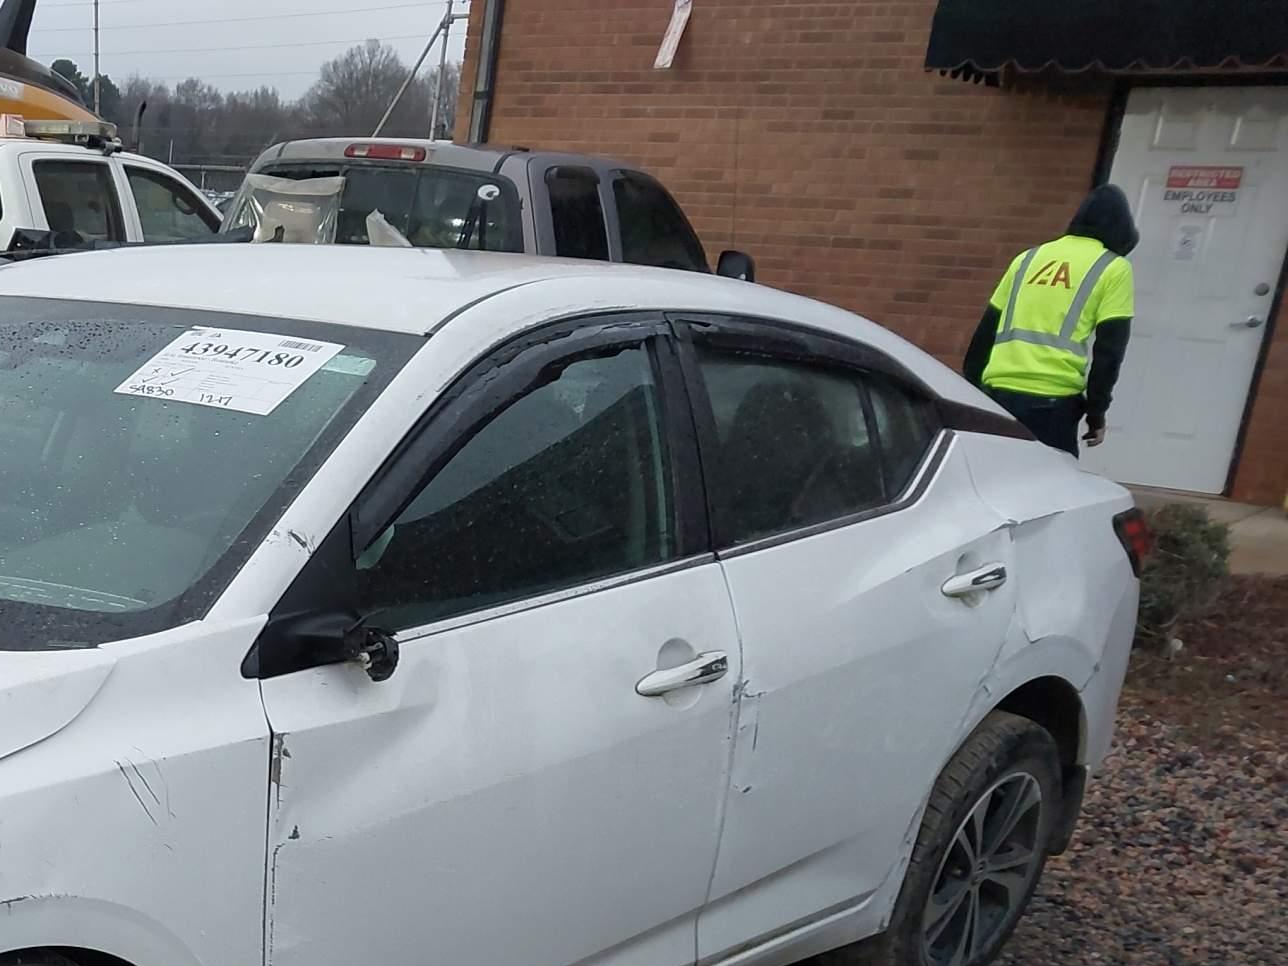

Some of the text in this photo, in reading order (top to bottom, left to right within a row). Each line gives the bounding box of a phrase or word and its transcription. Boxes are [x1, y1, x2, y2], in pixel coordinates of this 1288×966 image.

[1163, 190, 1236, 202] EMPLOYEES
[1181, 203, 1214, 213] ONLY
[180, 342, 305, 368] 43947180
